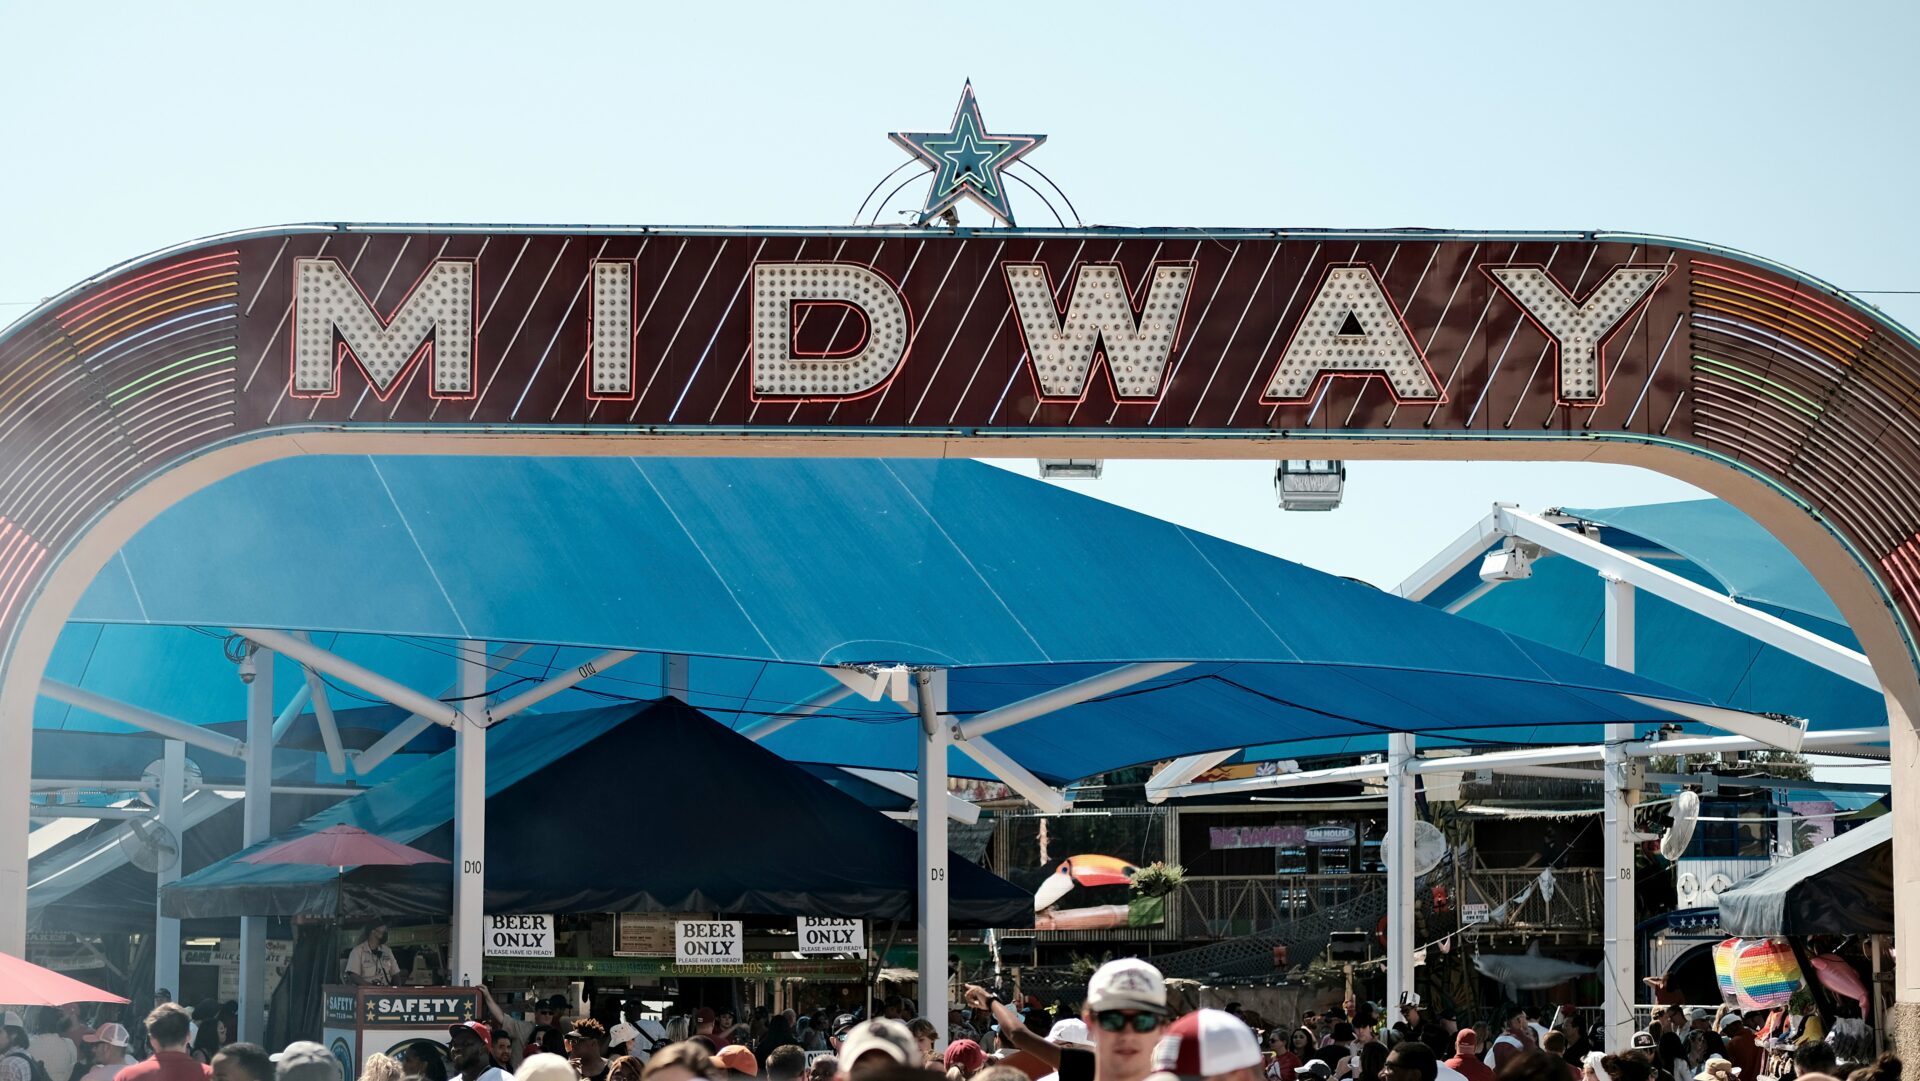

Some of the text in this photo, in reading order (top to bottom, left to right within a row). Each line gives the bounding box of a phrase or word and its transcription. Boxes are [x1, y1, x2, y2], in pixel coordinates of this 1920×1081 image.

[290, 256, 1675, 404] MIDWAY
[464, 860, 482, 875] D10
[931, 868, 944, 880] D9
[1620, 868, 1631, 880] D8
[492, 914, 547, 930] BEER
[683, 923, 735, 938] BEER
[806, 929, 855, 944] ONLY
[493, 932, 546, 947] ONLY
[684, 940, 735, 955] ONLY
[671, 962, 763, 974] COWBOY NACHOS
[329, 996, 354, 1012] SAFETY
[378, 998, 459, 1013] SAFETY
